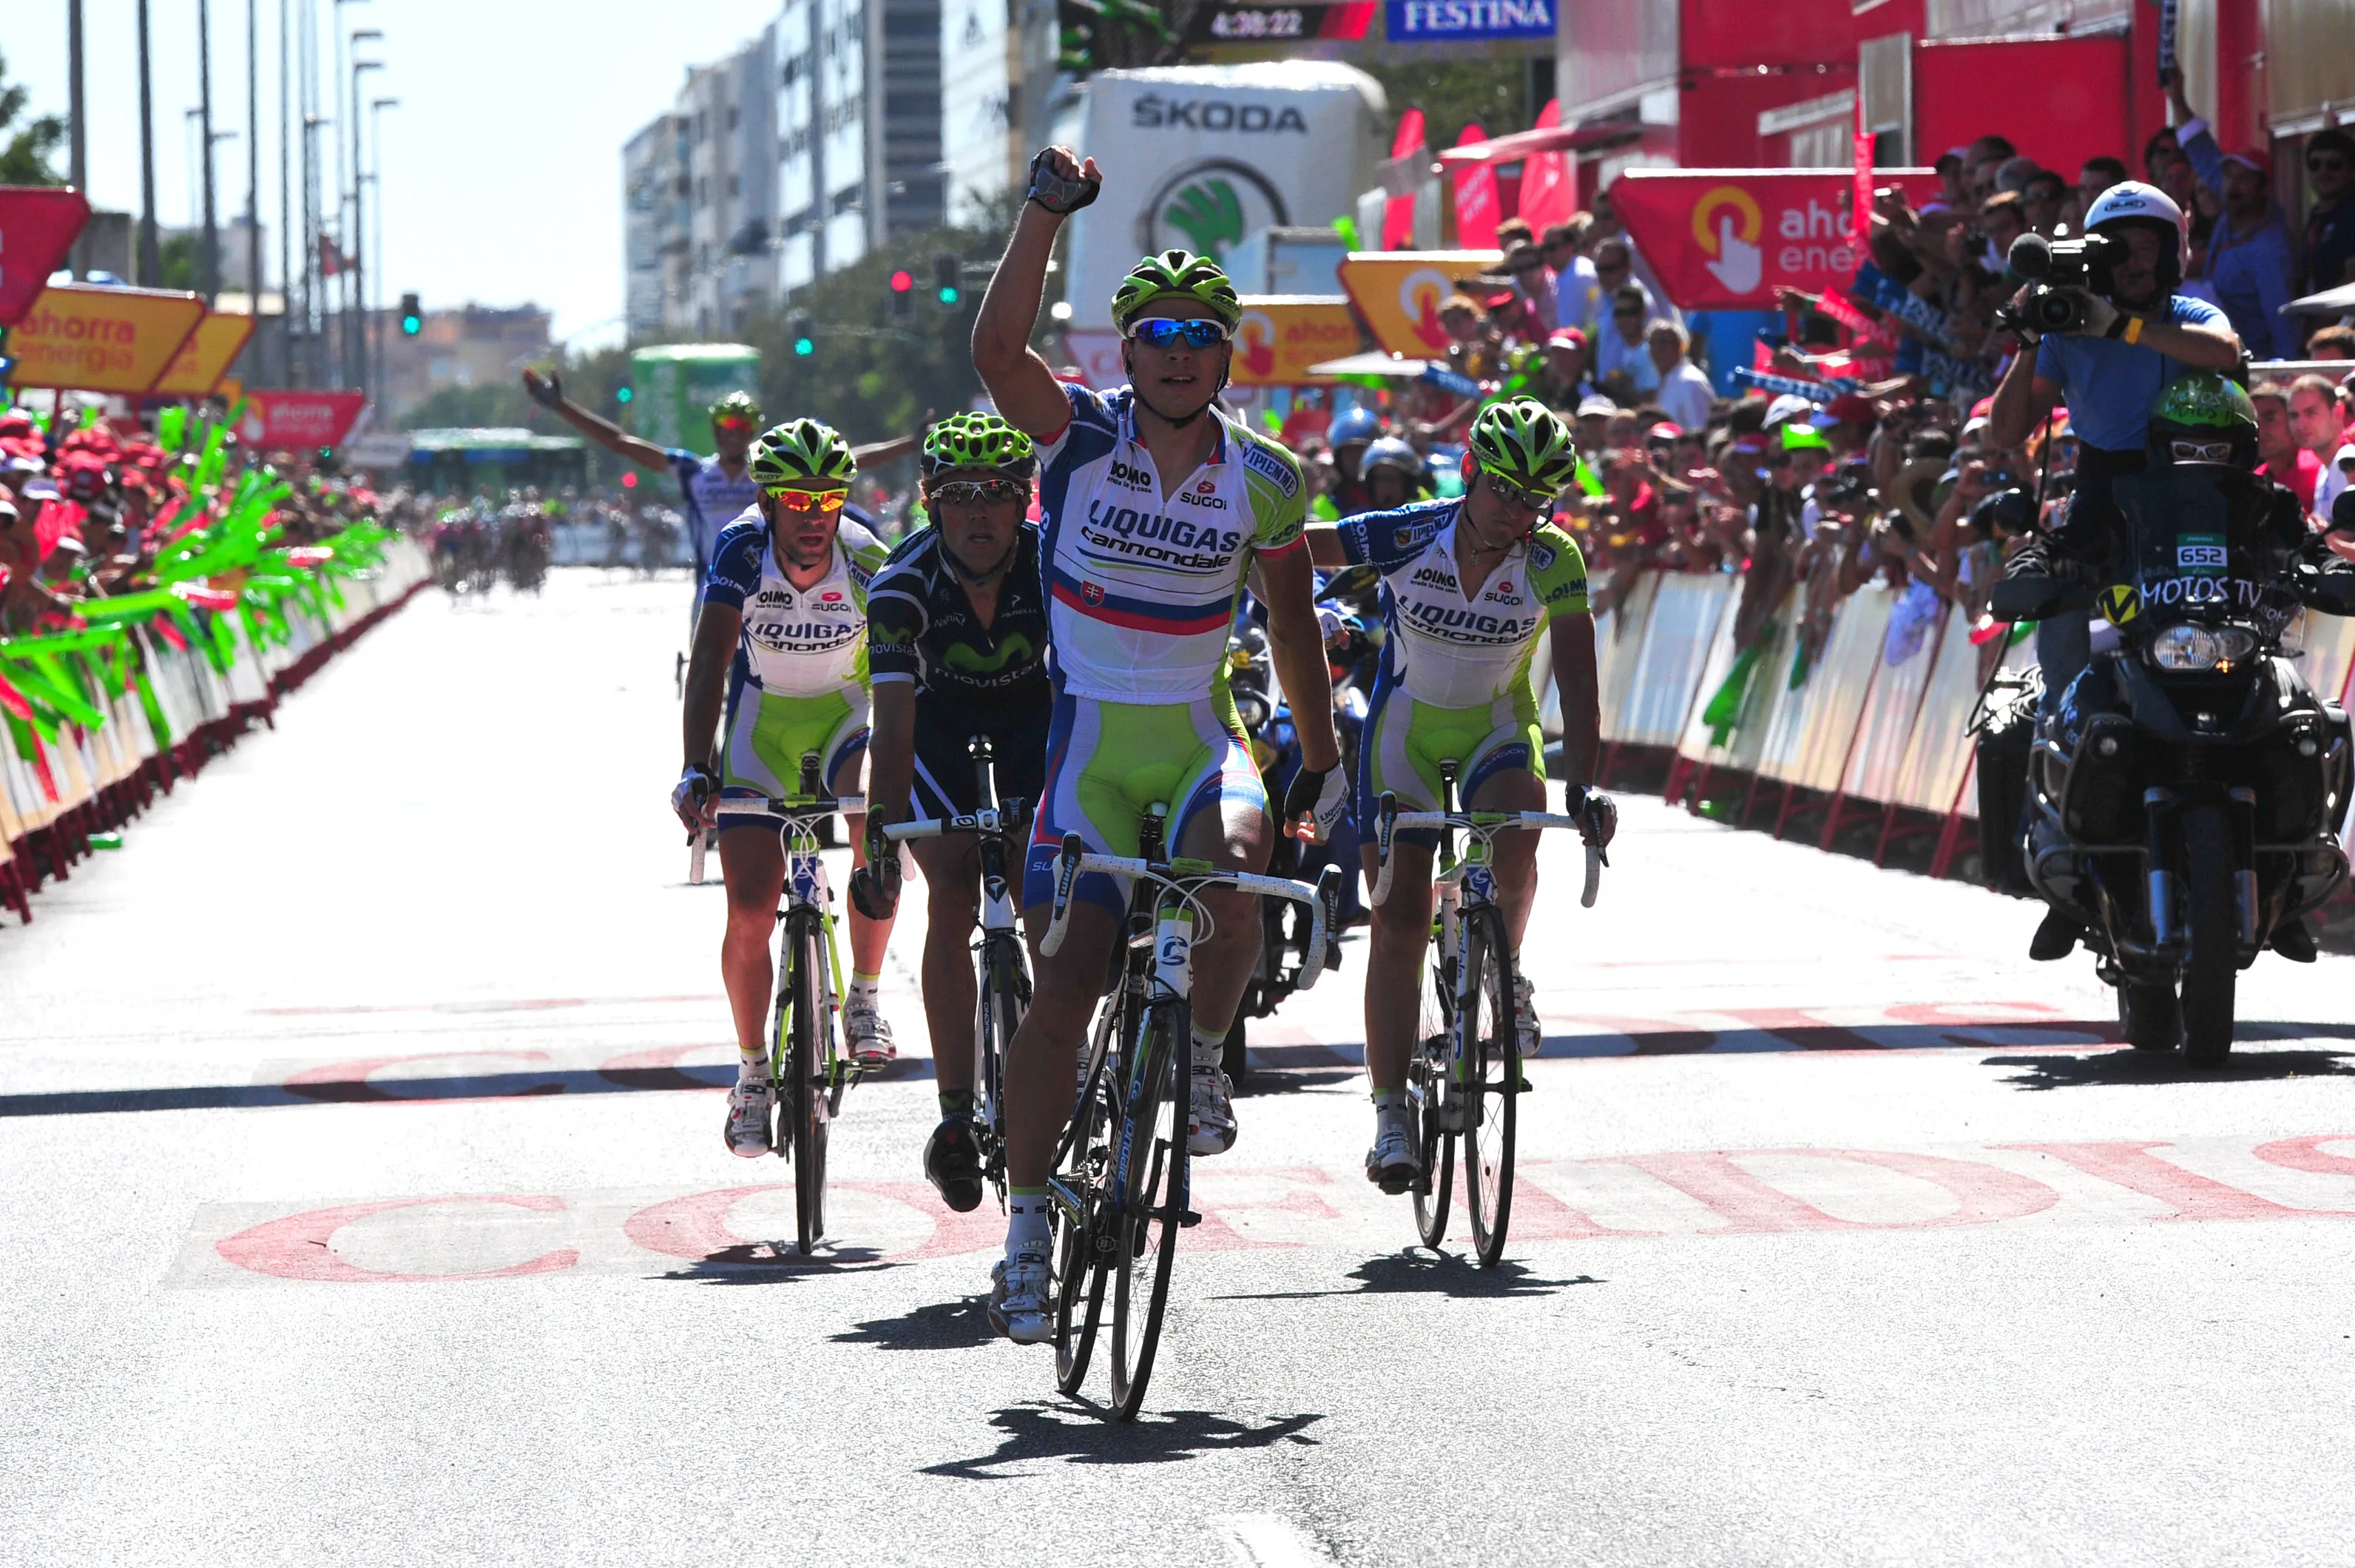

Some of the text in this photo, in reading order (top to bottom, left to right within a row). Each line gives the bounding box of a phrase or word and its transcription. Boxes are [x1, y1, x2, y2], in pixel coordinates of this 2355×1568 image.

[1405, 0, 1552, 32] FESTINA
[1133, 92, 1309, 135] ŠKODA
[1778, 197, 1854, 238] aho
[1089, 499, 1240, 552] LIQUIGAS
[1081, 526, 1231, 568] cannondale
[2180, 547, 2223, 564] 652
[2141, 576, 2229, 609] MOTOS
[2234, 579, 2262, 609] TV
[1398, 595, 1535, 635] LIQUIGAS
[934, 658, 1041, 689] movistar
[1061, 854, 1075, 895] SRAM
